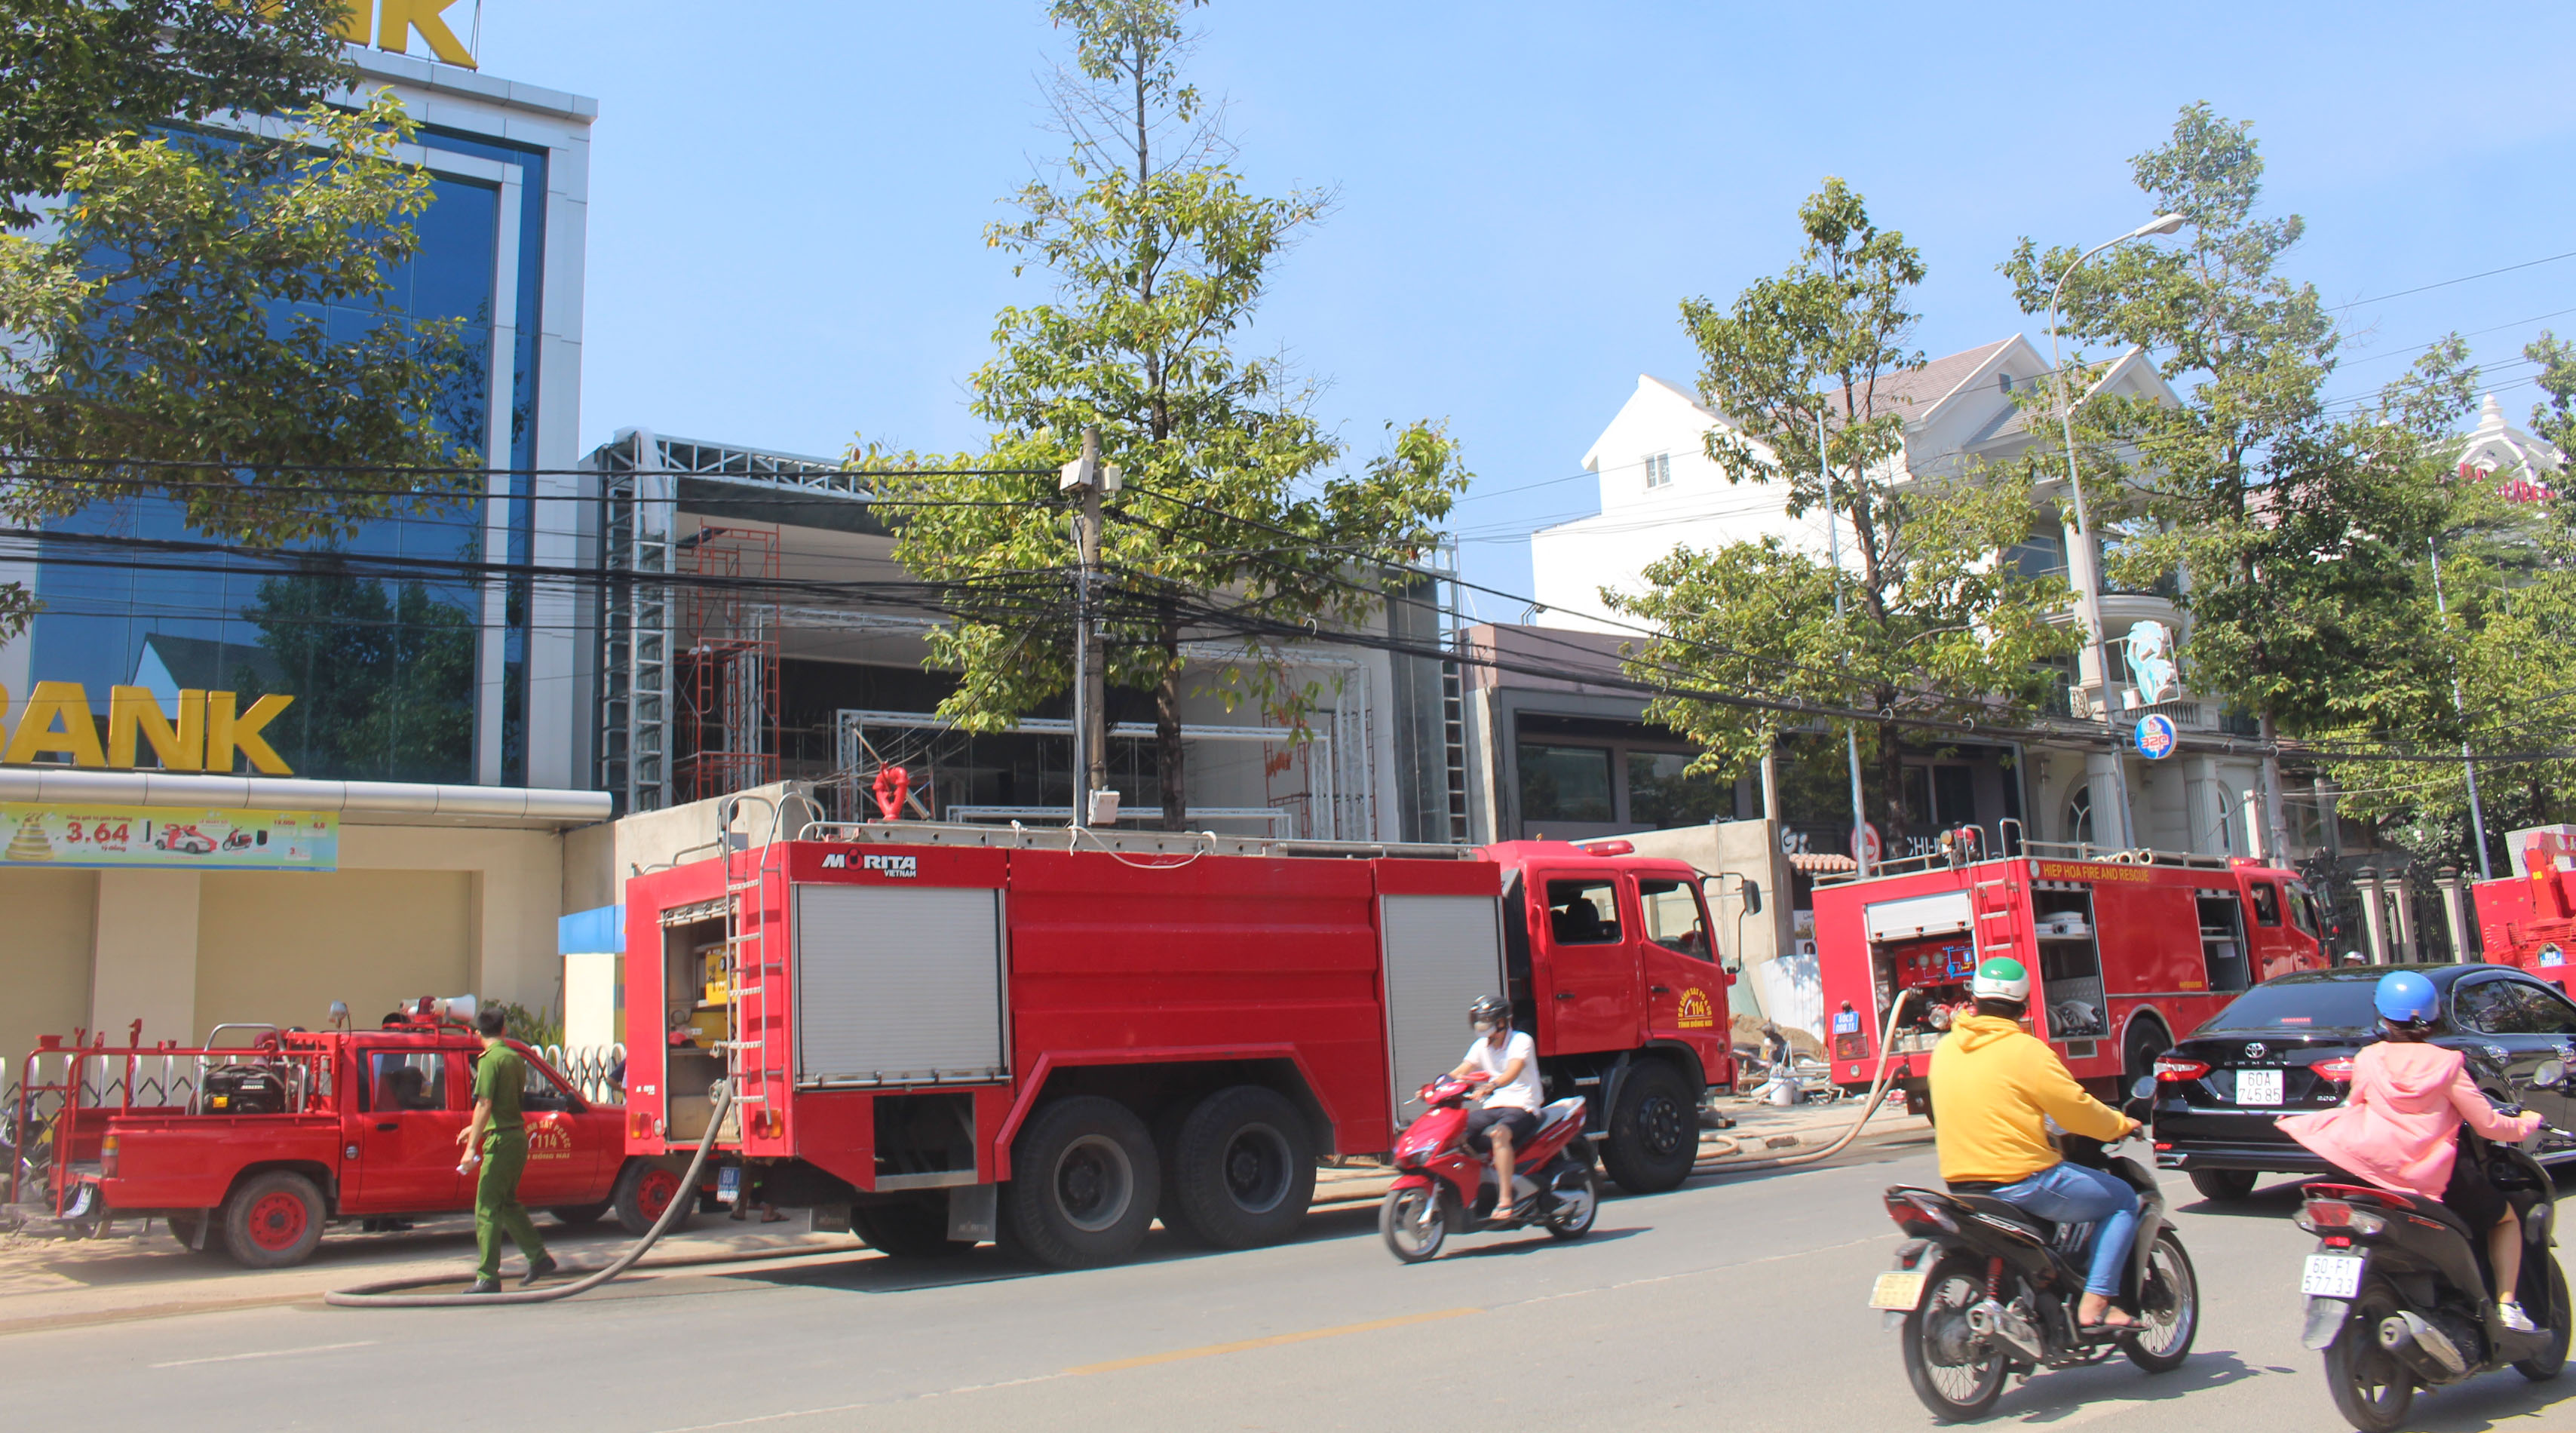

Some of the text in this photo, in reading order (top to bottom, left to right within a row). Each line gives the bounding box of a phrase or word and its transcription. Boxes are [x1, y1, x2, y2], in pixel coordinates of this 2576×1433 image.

[0, 680, 296, 775] ANK
[66, 821, 130, 843] 3.64
[821, 848, 917, 871] MORITA
[884, 870, 917, 878] VIETNAM
[2043, 863, 2149, 882] HIEP HOA FIRE AND RESCUE
[1691, 1001, 1705, 1015] 114
[2248, 1072, 2271, 1087] 60A
[536, 1134, 557, 1149] 114
